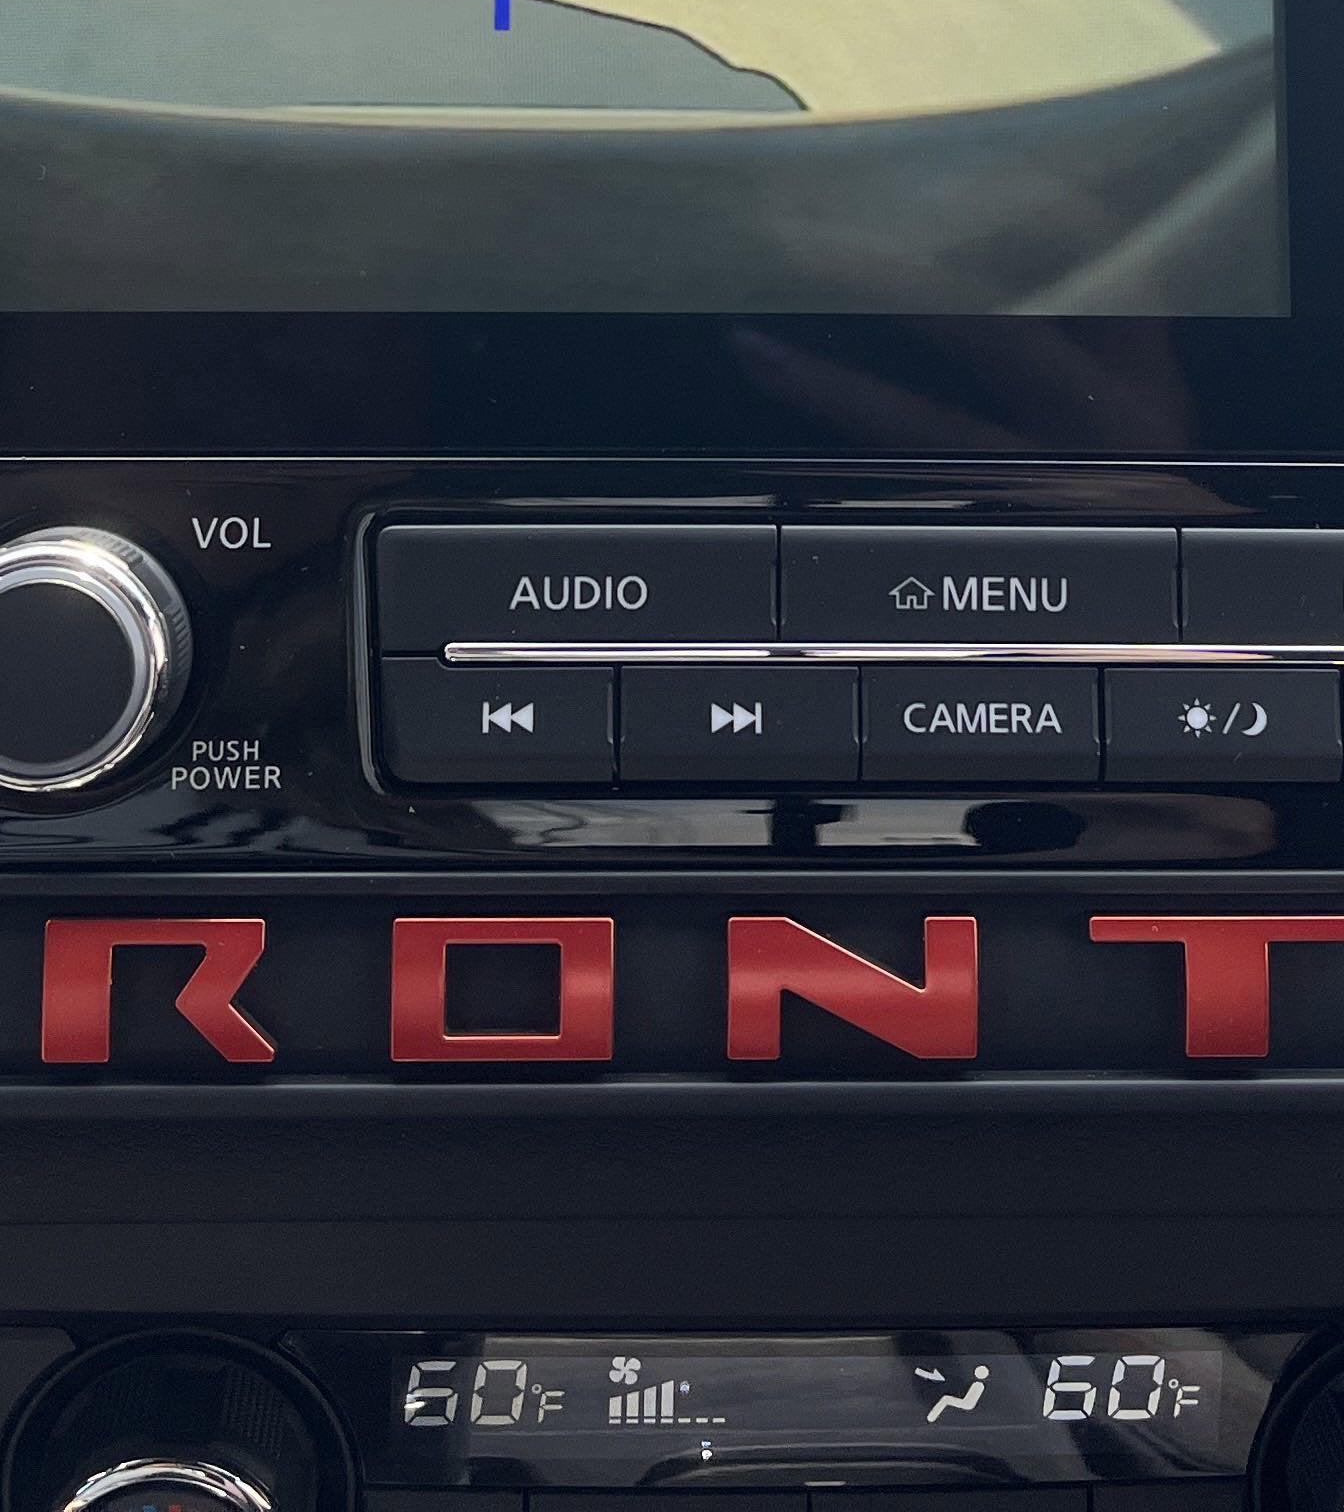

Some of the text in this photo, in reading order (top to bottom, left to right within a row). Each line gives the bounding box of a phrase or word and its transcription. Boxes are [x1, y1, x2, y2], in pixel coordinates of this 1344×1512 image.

[191, 516, 272, 549] VOL
[509, 575, 648, 611] AUDIO
[943, 576, 1068, 612] MENU
[903, 702, 1062, 735] CAMERA
[192, 739, 260, 762] PUSH
[171, 765, 282, 790] POWER
